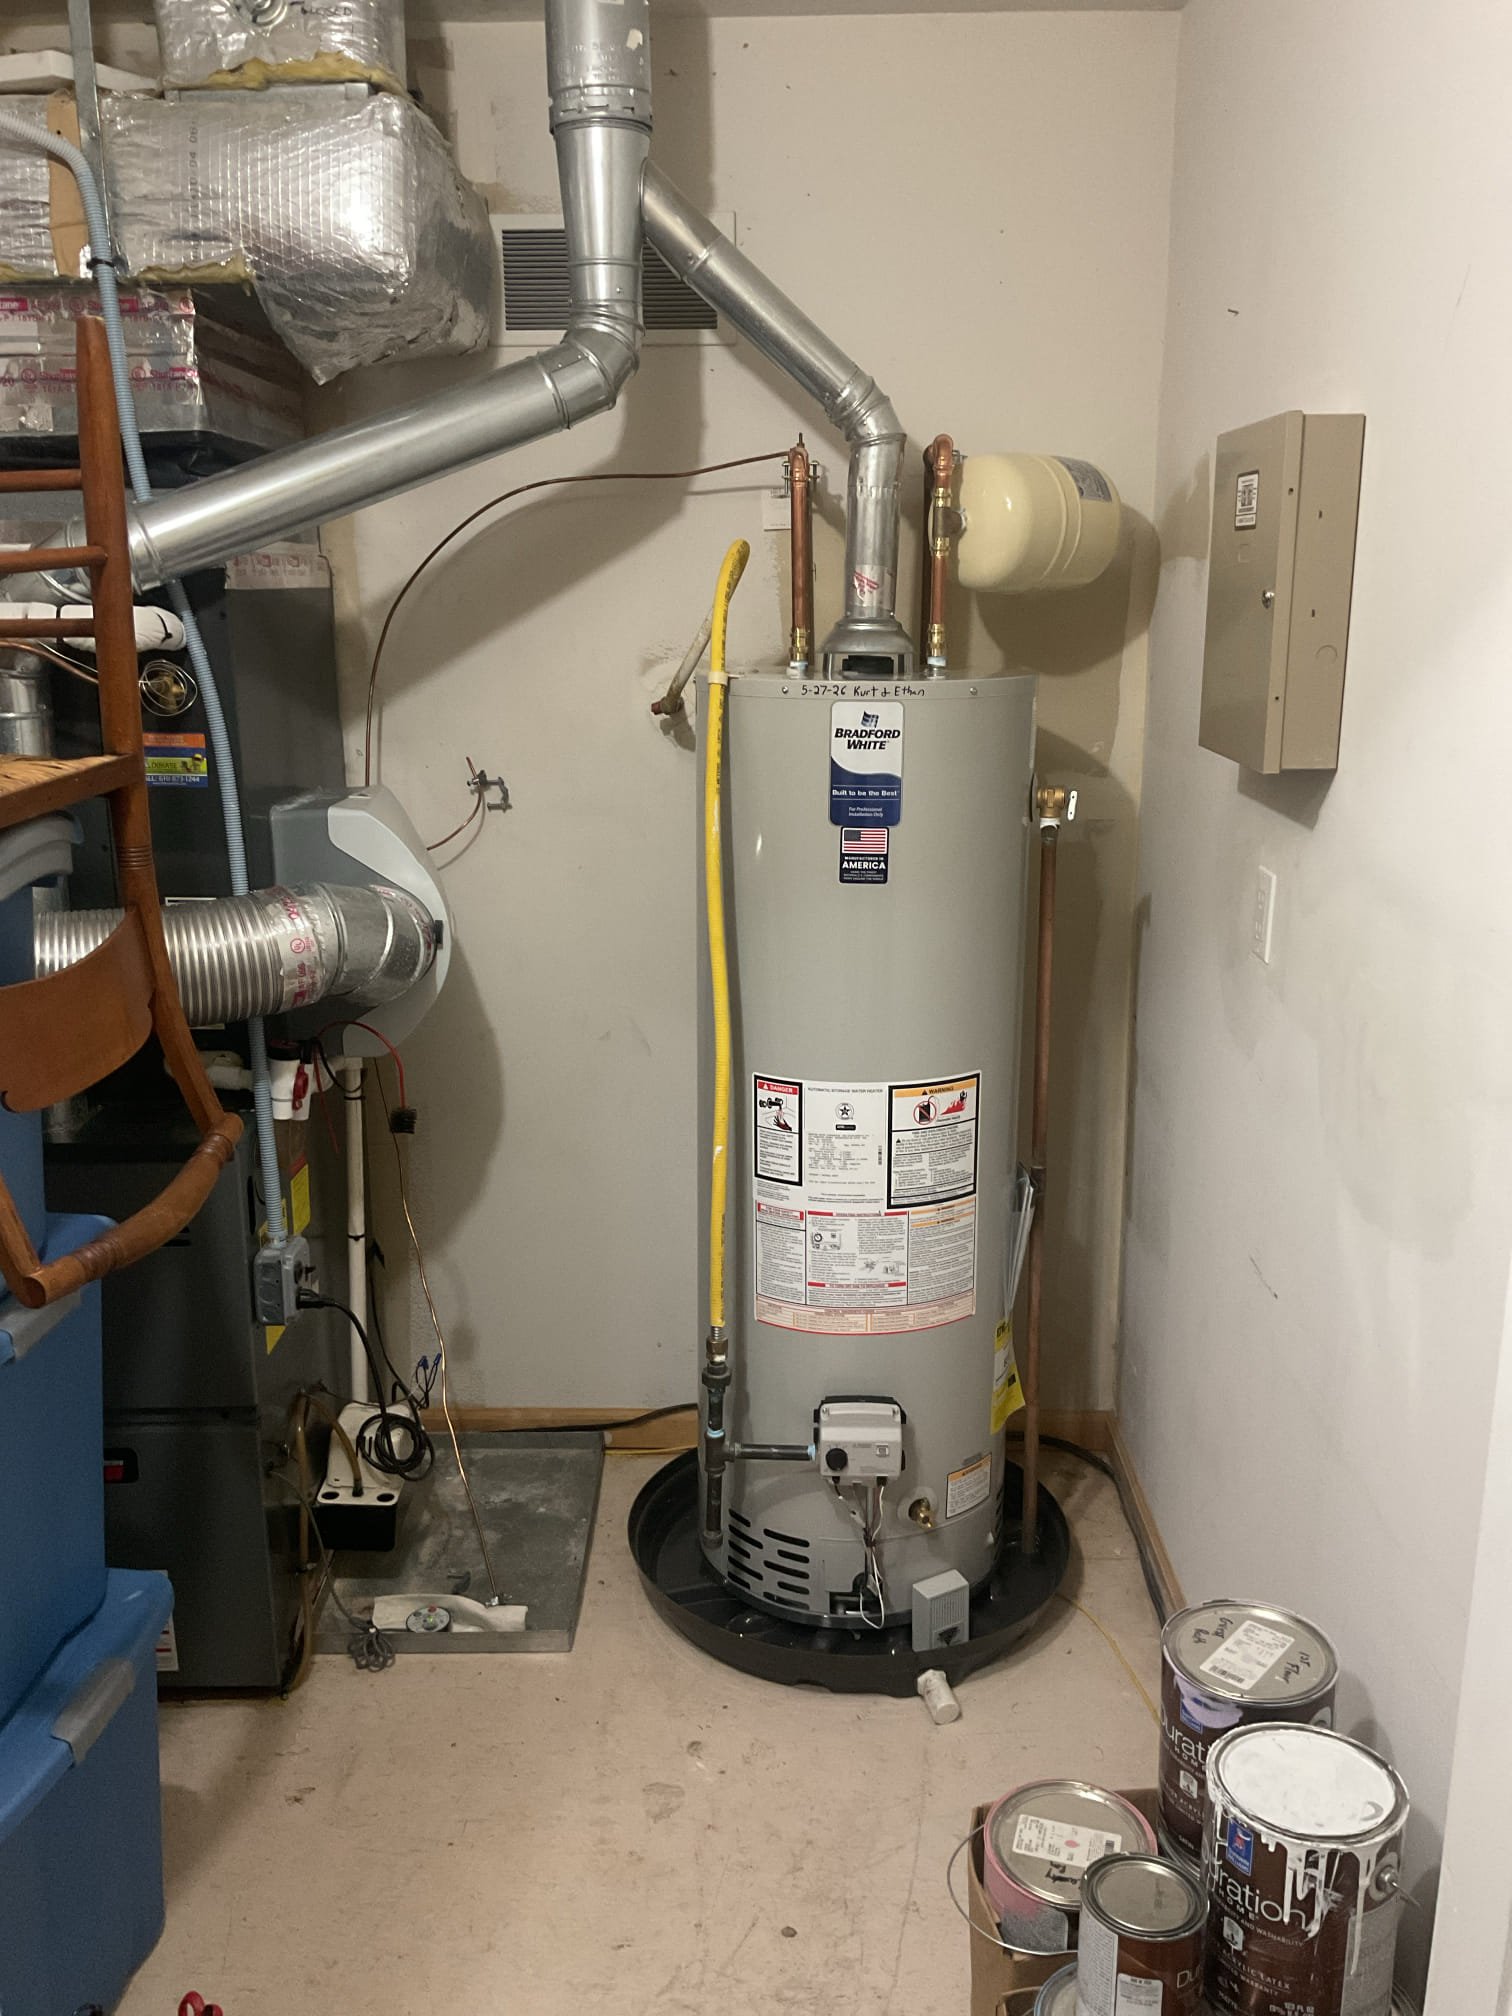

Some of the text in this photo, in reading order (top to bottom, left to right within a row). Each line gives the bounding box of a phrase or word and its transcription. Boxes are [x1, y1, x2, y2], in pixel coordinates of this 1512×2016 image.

[801, 684, 847, 696] 5-27-26
[853, 685, 879, 697] Kurt
[894, 685, 925, 697] Ethan
[834, 728, 901, 739] BRADFORD
[847, 739, 887, 750] WHITE
[842, 861, 886, 870] AMERICA
[769, 1084, 793, 1093] DANGER
[929, 1086, 954, 1095] WARNING
[1256, 1927, 1304, 1946] WASHABILITY
